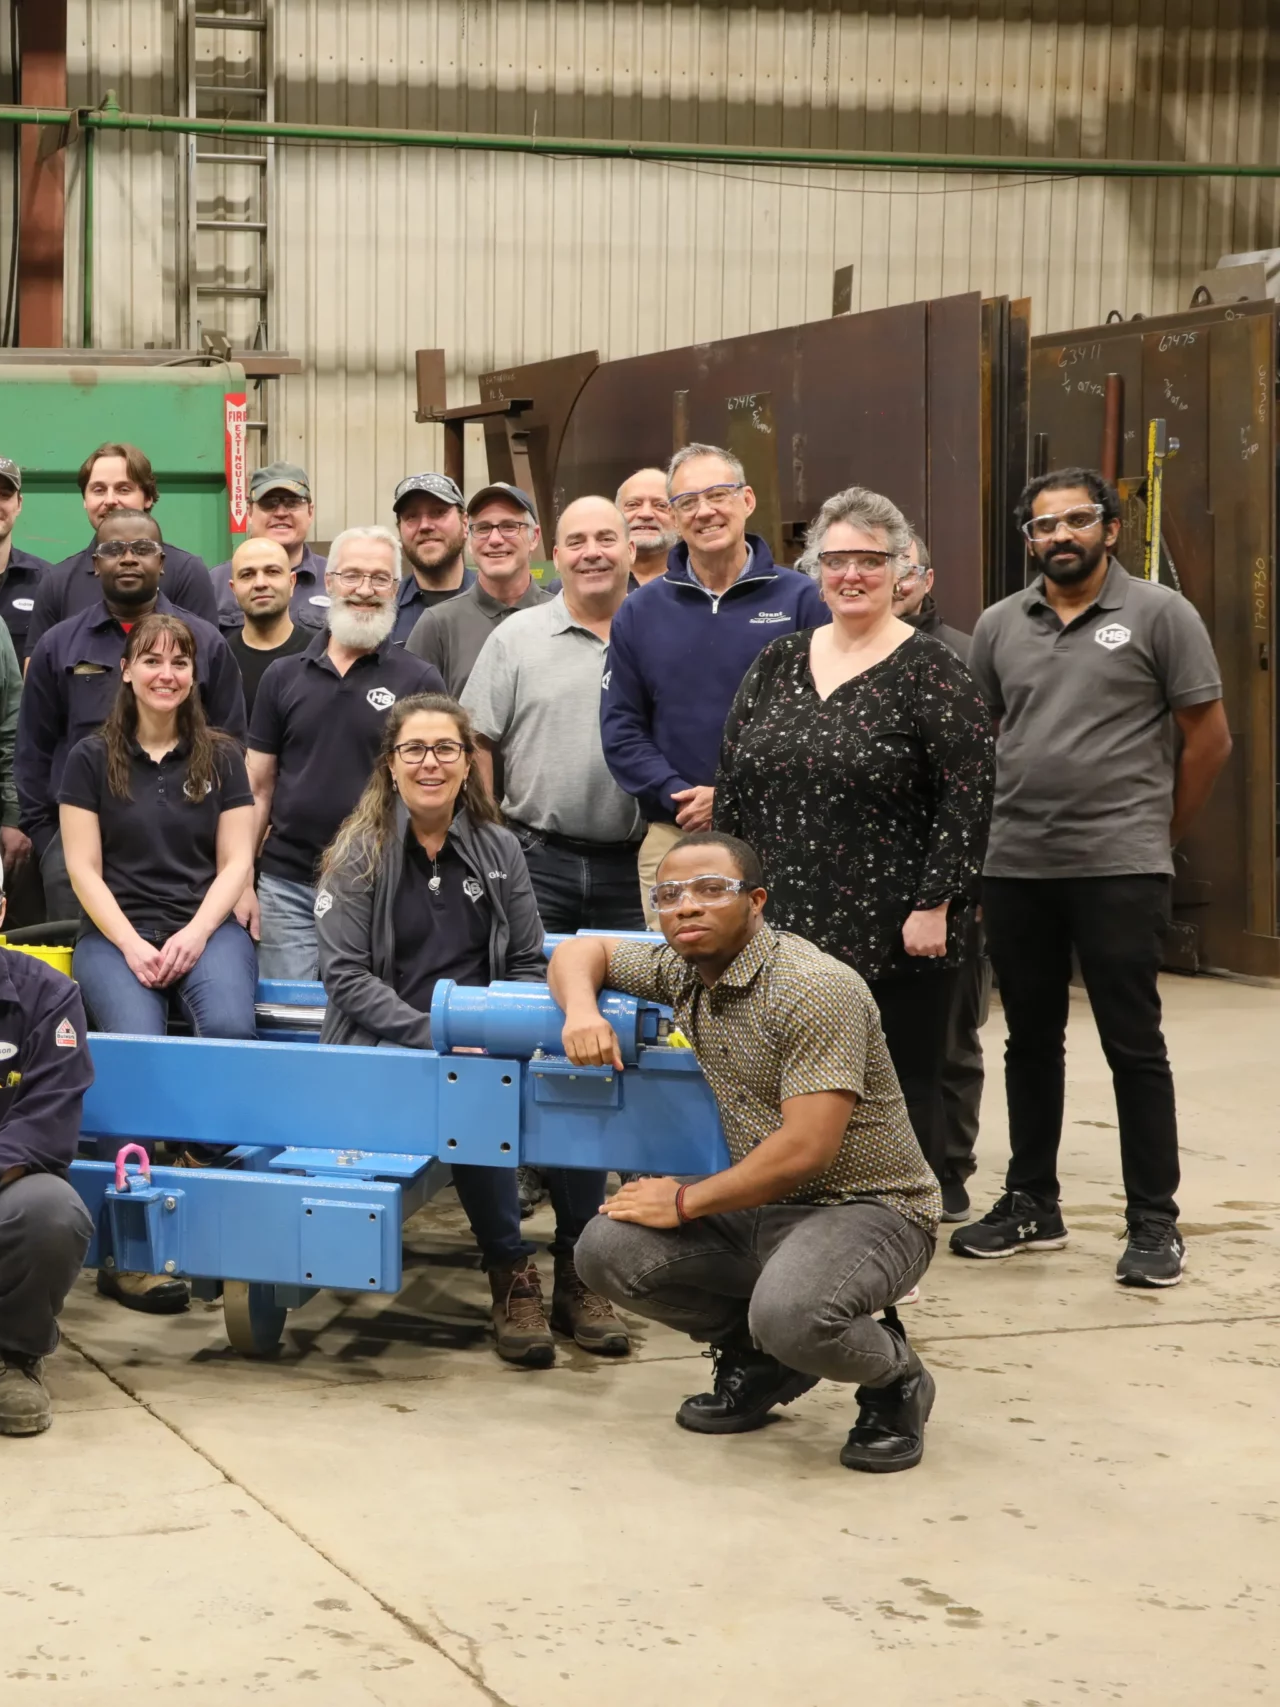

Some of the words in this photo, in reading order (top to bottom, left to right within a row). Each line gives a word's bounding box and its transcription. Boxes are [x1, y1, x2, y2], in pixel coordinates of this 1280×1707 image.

[1158, 331, 1199, 352] 67475
[1058, 343, 1101, 368] 63411
[727, 395, 757, 410] 67415
[228, 411, 247, 422] FIRE
[1254, 557, 1267, 630] 1701750
